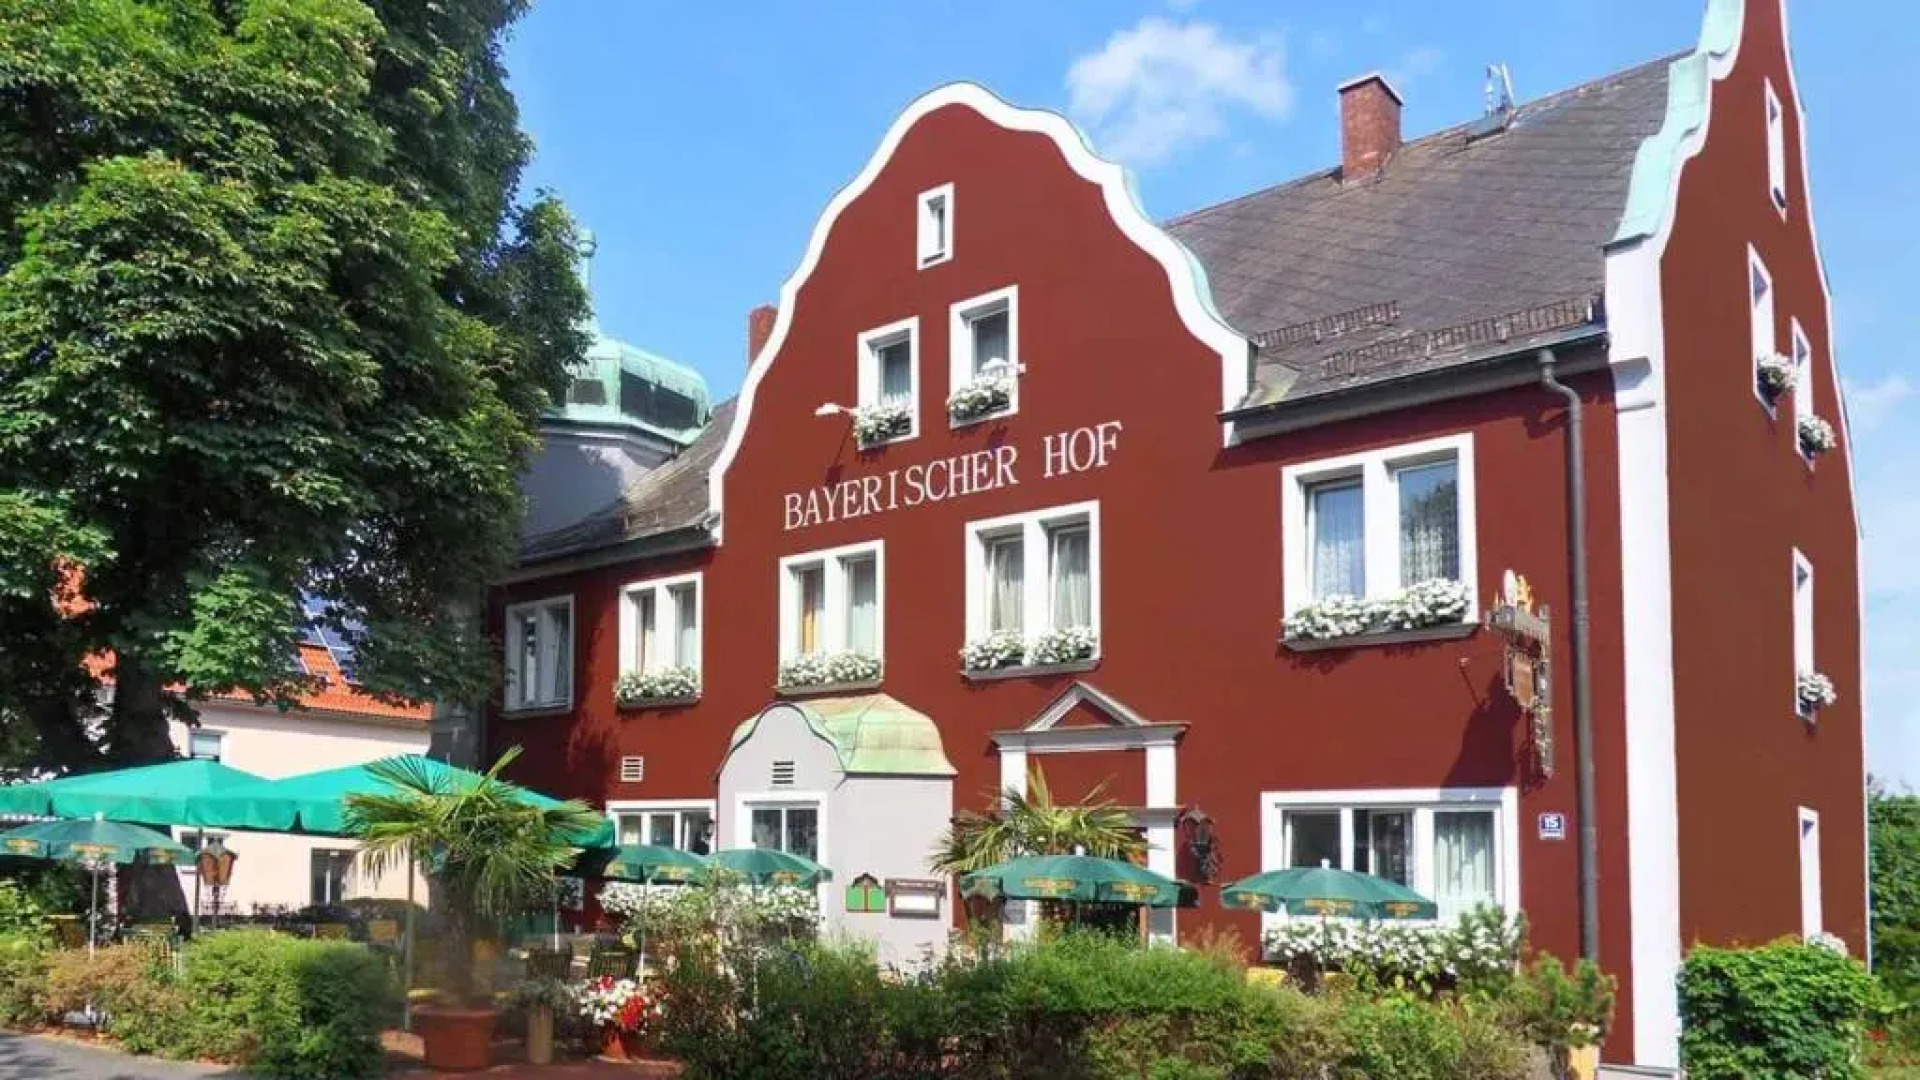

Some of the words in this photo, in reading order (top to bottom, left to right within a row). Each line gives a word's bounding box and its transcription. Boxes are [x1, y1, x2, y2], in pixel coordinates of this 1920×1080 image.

[783, 446, 1020, 531] BAYERISCHER
[1043, 420, 1124, 479] HOF
[1544, 815, 1559, 828] 15
